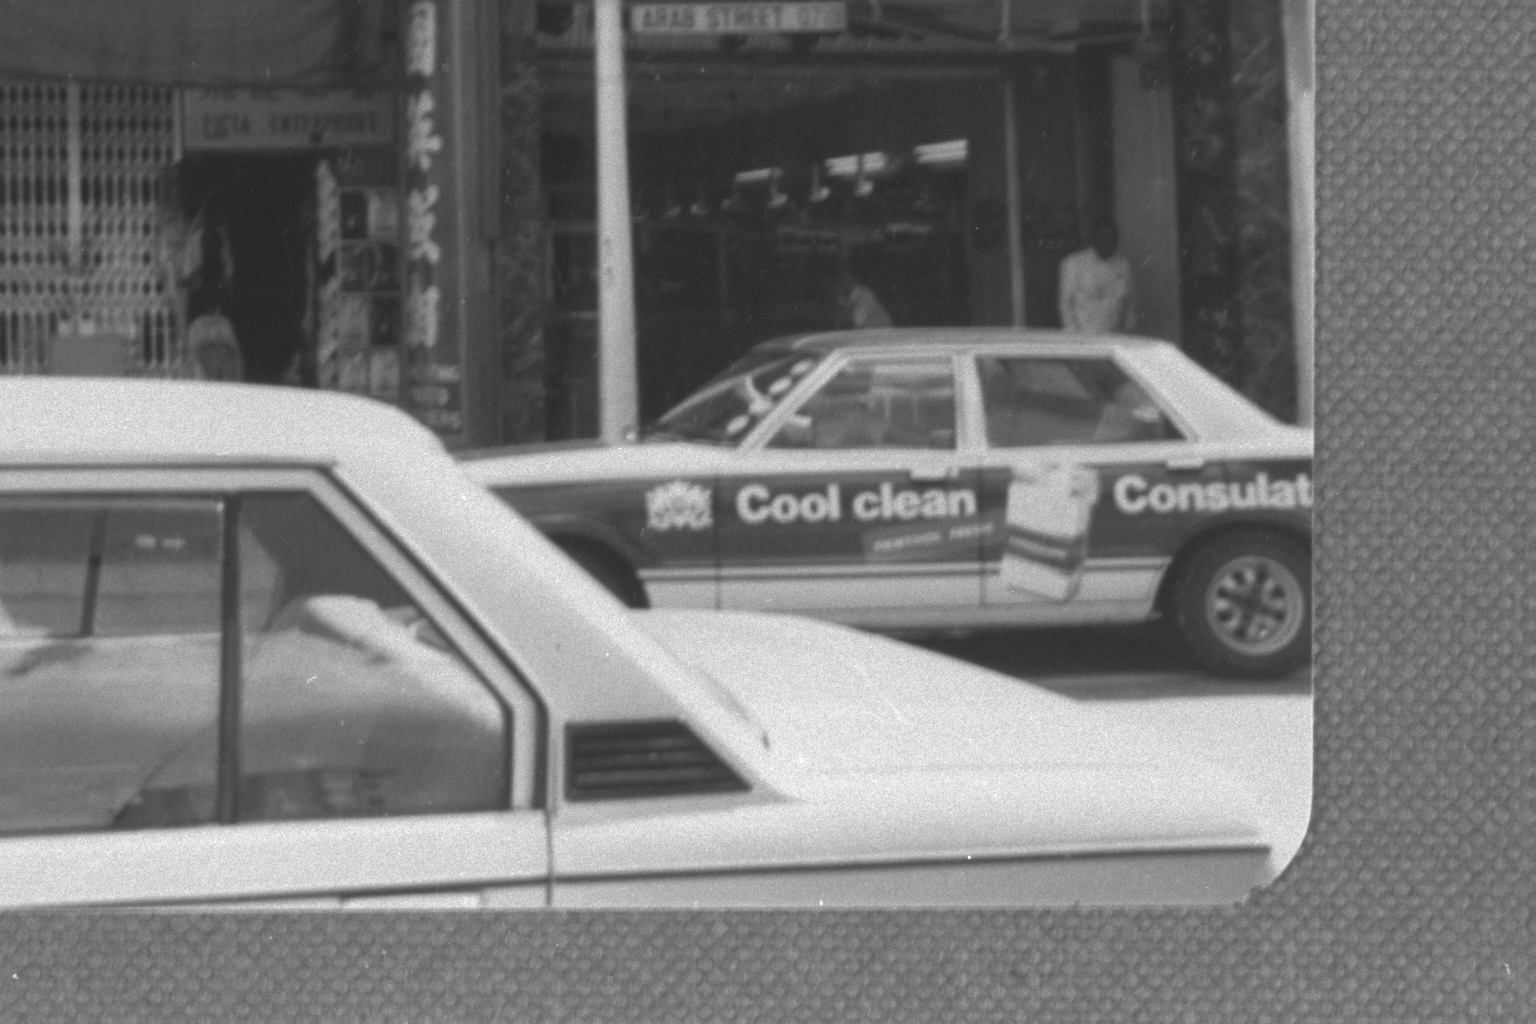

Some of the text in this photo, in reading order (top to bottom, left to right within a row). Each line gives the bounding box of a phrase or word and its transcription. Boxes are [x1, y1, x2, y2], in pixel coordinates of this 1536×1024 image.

[706, 4, 783, 27] STREET
[737, 481, 841, 523] Cool
[853, 478, 976, 521] clean
